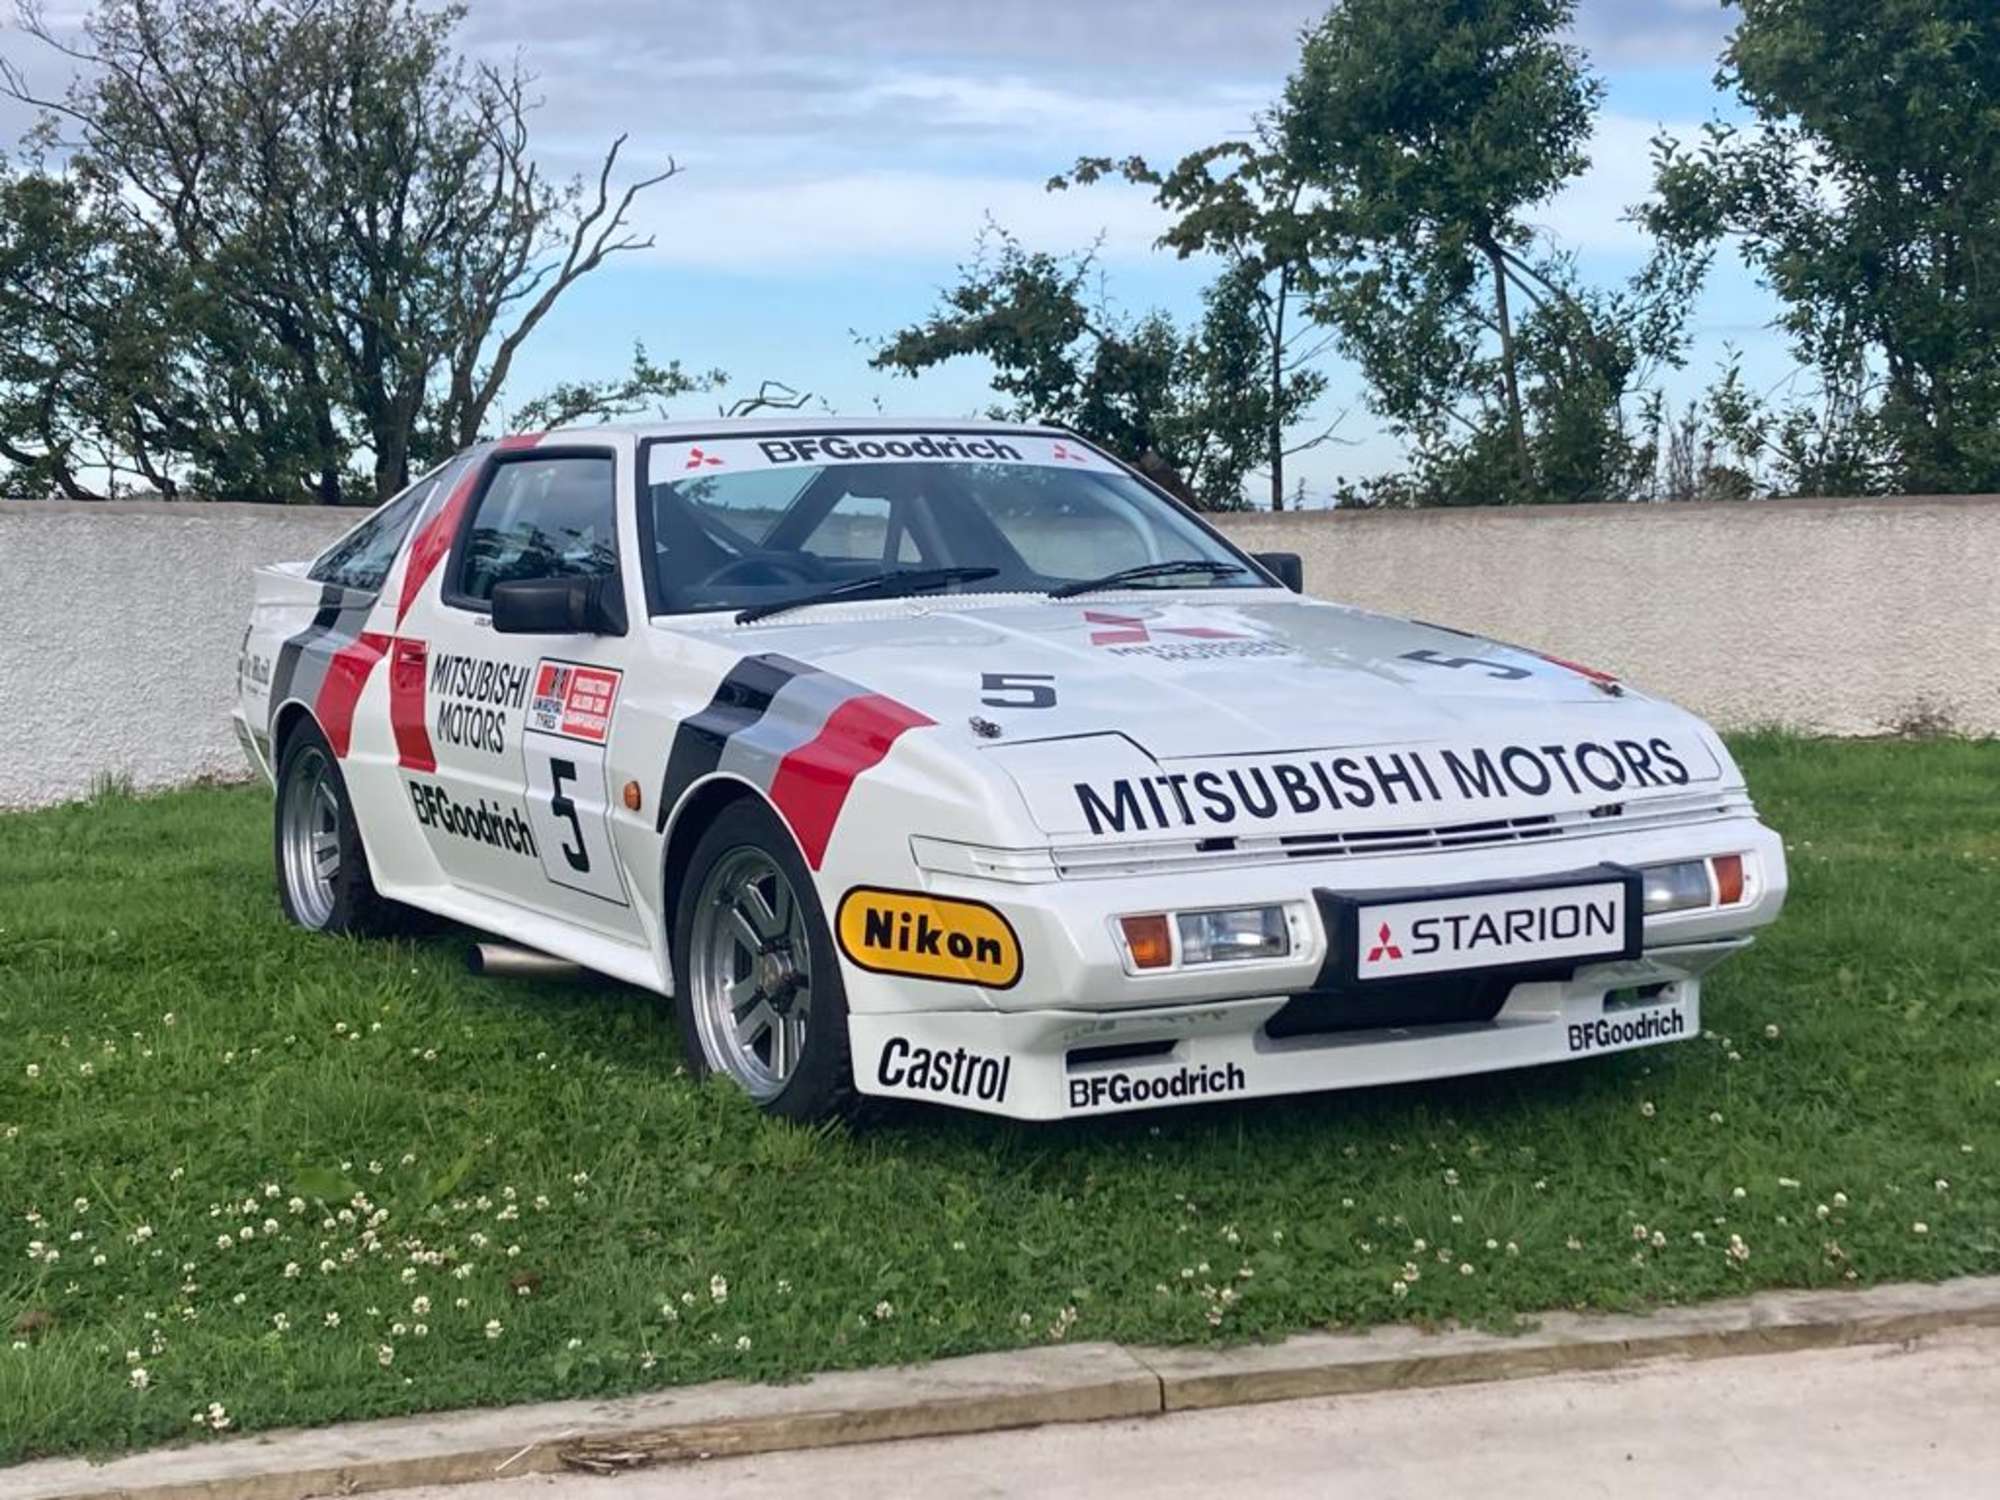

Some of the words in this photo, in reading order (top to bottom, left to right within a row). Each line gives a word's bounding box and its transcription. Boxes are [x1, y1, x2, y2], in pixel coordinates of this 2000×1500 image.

[758, 437, 1022, 464] BFGoodrich
[430, 654, 530, 709] MITSUBISHI
[981, 672, 1057, 708] 5
[1398, 650, 1533, 680] 5
[438, 701, 506, 753] MOTORS
[1075, 751, 1442, 835] MITSUBISHI
[1442, 737, 1689, 799] MOTORS
[409, 781, 538, 858] BFGoodrich
[550, 757, 590, 873] 5
[864, 907, 1002, 966] Nikon
[1411, 901, 1615, 954] STARION
[1568, 1008, 1684, 1051] BFGoodrich
[878, 1036, 1011, 1103] Castrol
[1069, 1063, 1245, 1108] BFGoodrich
